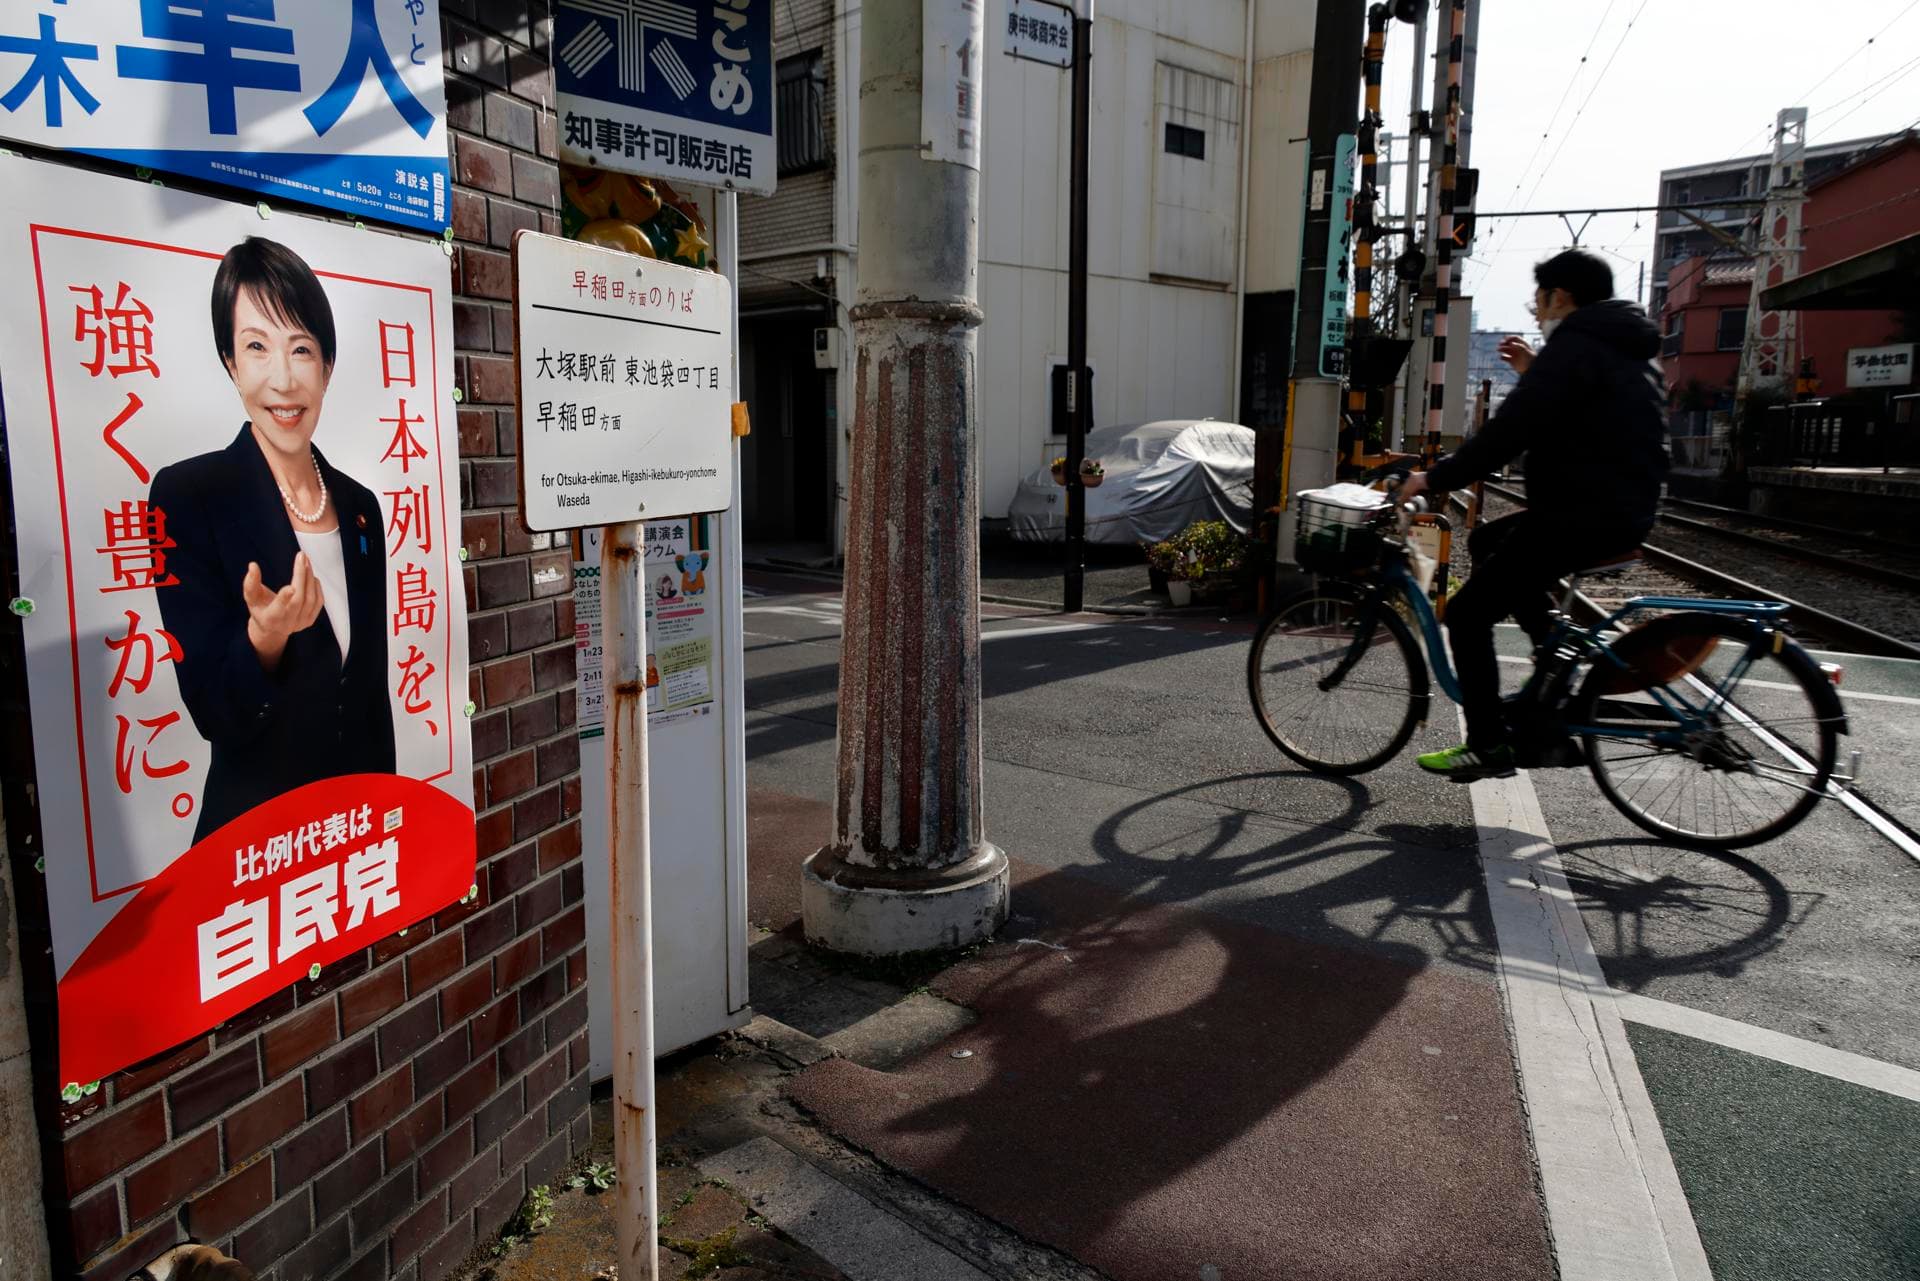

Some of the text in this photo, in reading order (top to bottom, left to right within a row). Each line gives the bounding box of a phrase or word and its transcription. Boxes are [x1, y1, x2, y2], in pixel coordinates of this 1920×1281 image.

[710, 0, 752, 115] こめ
[565, 111, 752, 179] 知事許可販売店
[395, 169, 429, 191] 演説会
[573, 270, 694, 313] 早稲田方面のりば
[536, 347, 719, 390] 大塚駅前 東池袋四丁目
[537, 401, 622, 432] 早稲田方面
[541, 466, 717, 487] for Otsuka-ekimae, Higashi-ikebukuro-yonchome
[557, 493, 590, 507] Waseda
[68, 281, 194, 818] 強く豊かに。
[378, 319, 438, 735] 日本列島を、
[232, 803, 372, 888] 比例代表は
[196, 836, 401, 1004] 自民党
